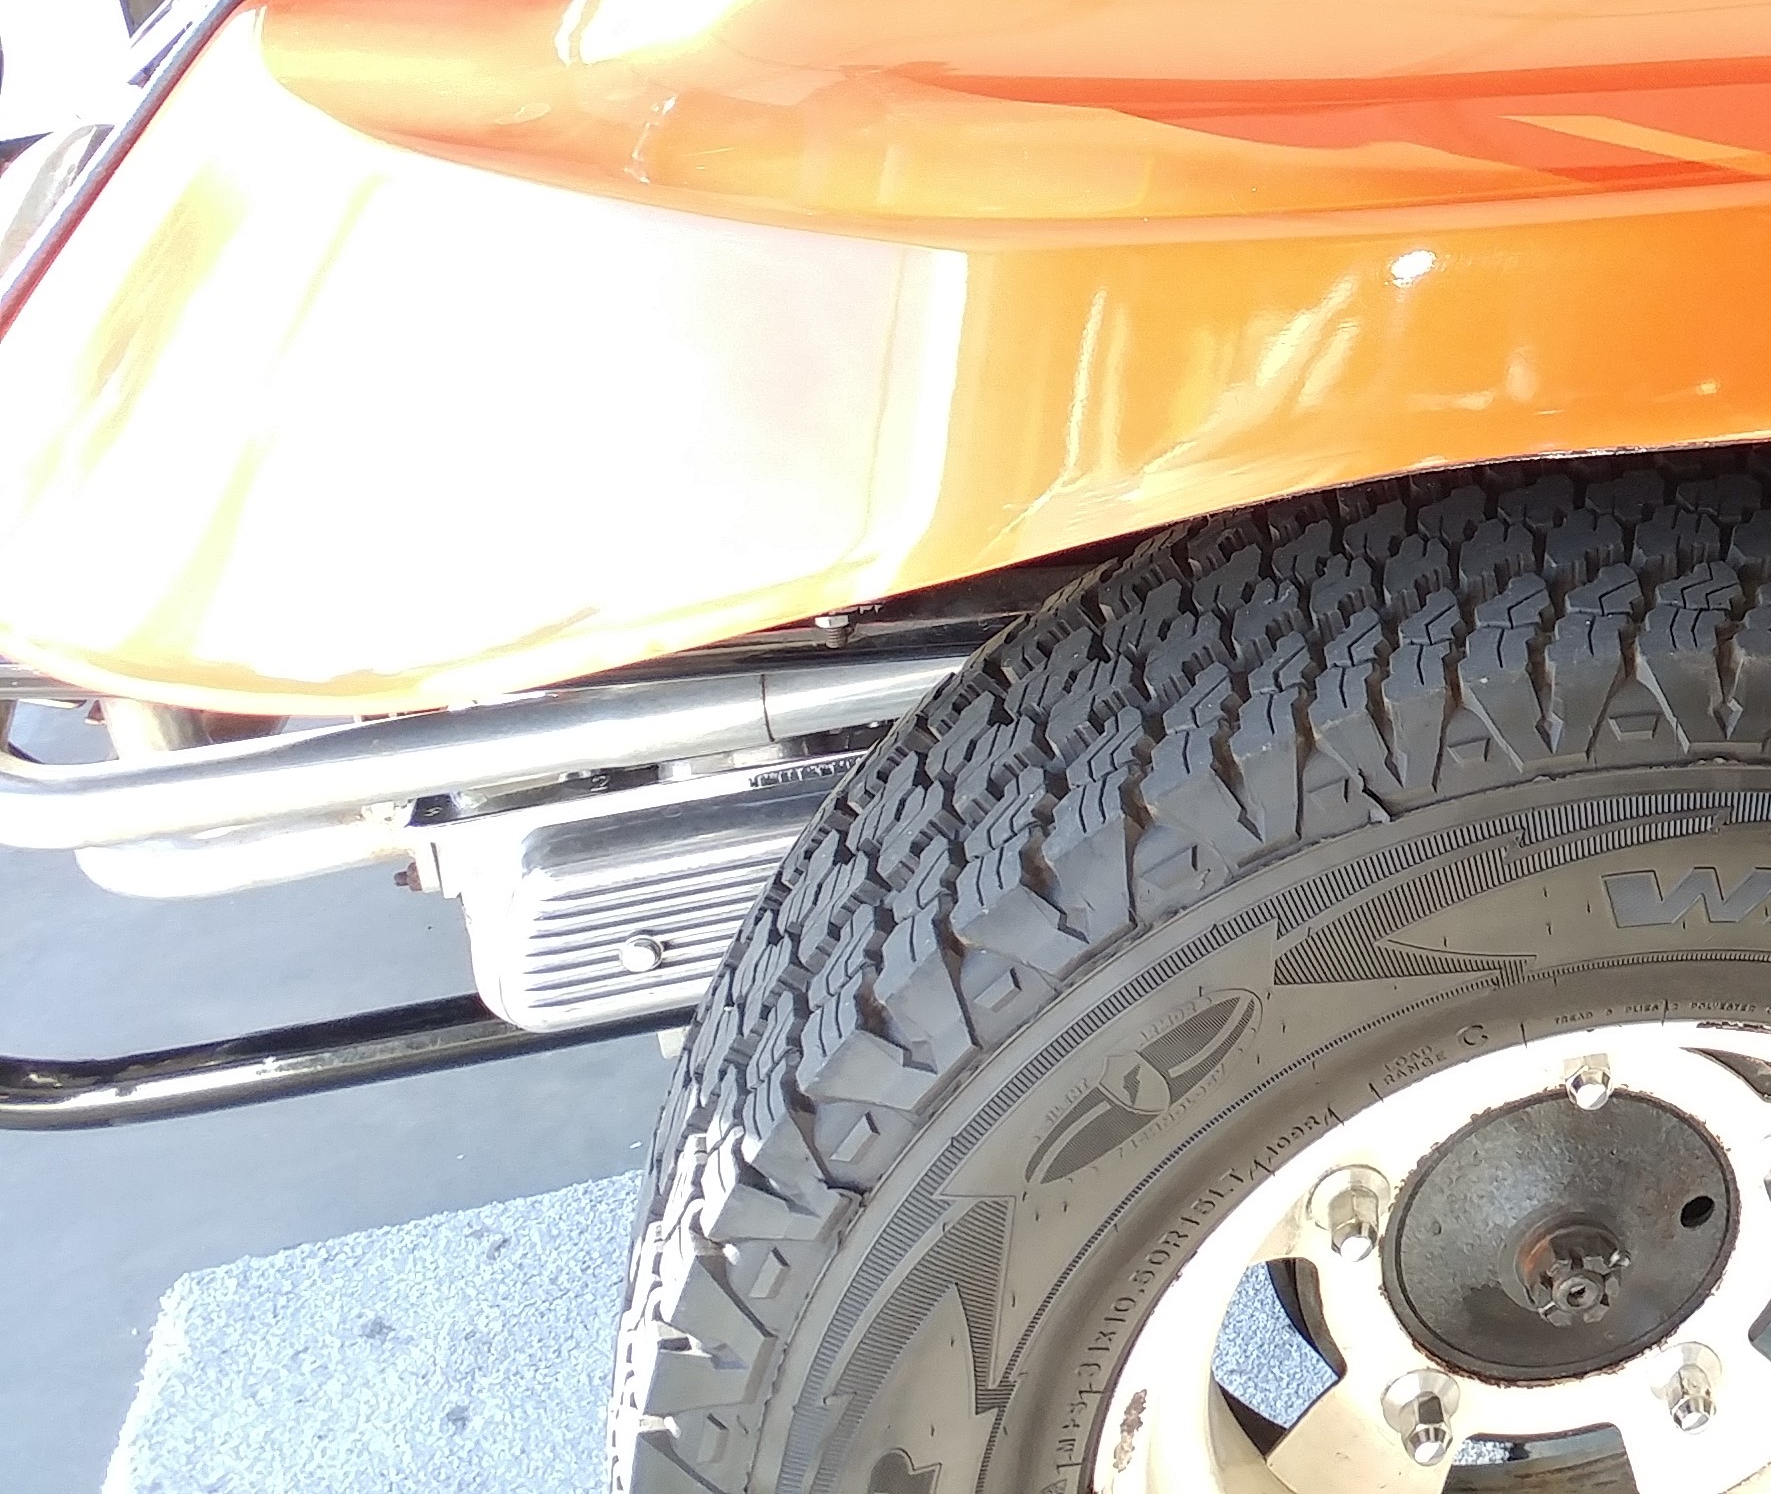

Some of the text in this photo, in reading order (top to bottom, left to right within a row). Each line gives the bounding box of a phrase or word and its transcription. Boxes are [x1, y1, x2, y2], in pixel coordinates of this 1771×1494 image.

[1384, 1024, 1489, 1086] LOAD RANGE C
